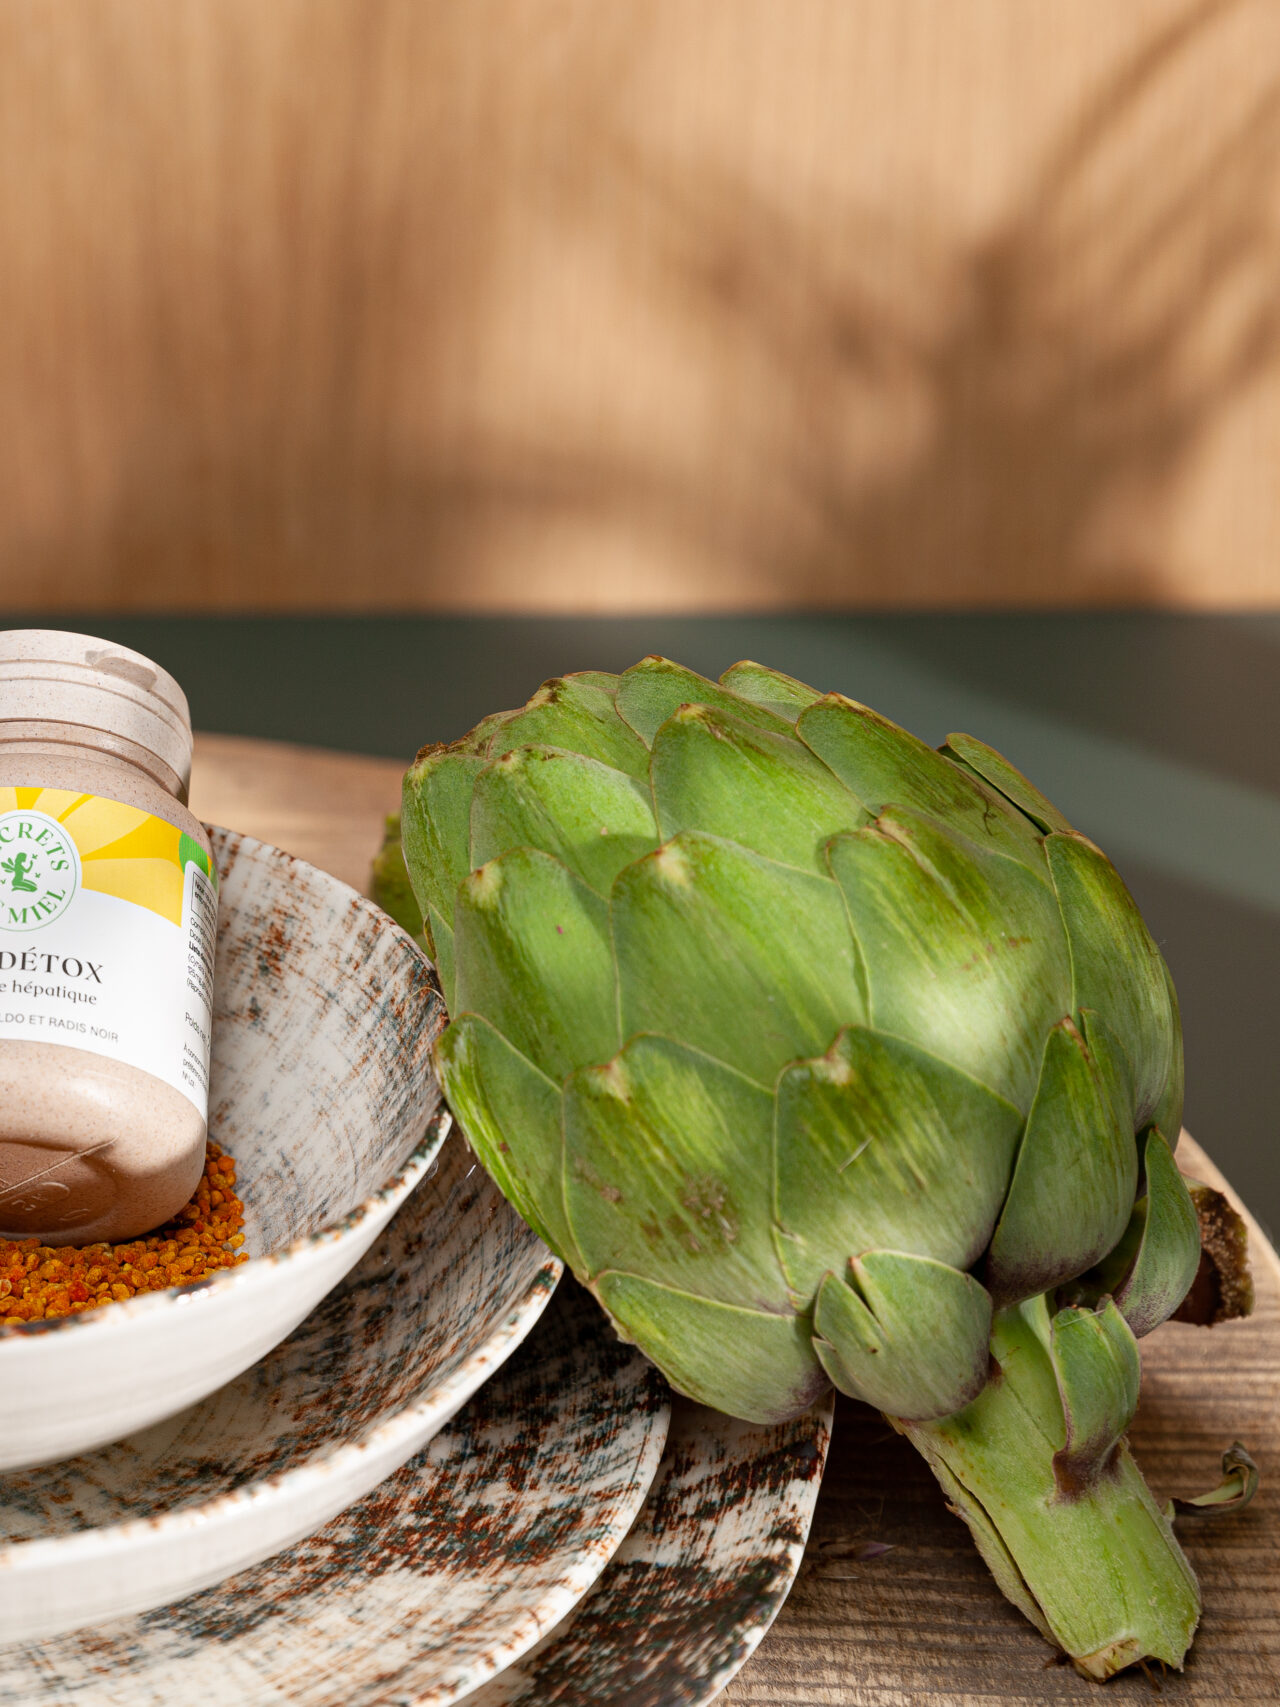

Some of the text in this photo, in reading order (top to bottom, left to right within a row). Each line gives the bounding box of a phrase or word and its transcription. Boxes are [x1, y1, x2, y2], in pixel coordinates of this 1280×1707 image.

[8, 889, 66, 924] MIEL
[12, 979, 98, 1005] hépatique
[29, 1014, 45, 1025] ET
[48, 1017, 87, 1034] RADIS
[90, 1025, 120, 1043] NOIR
